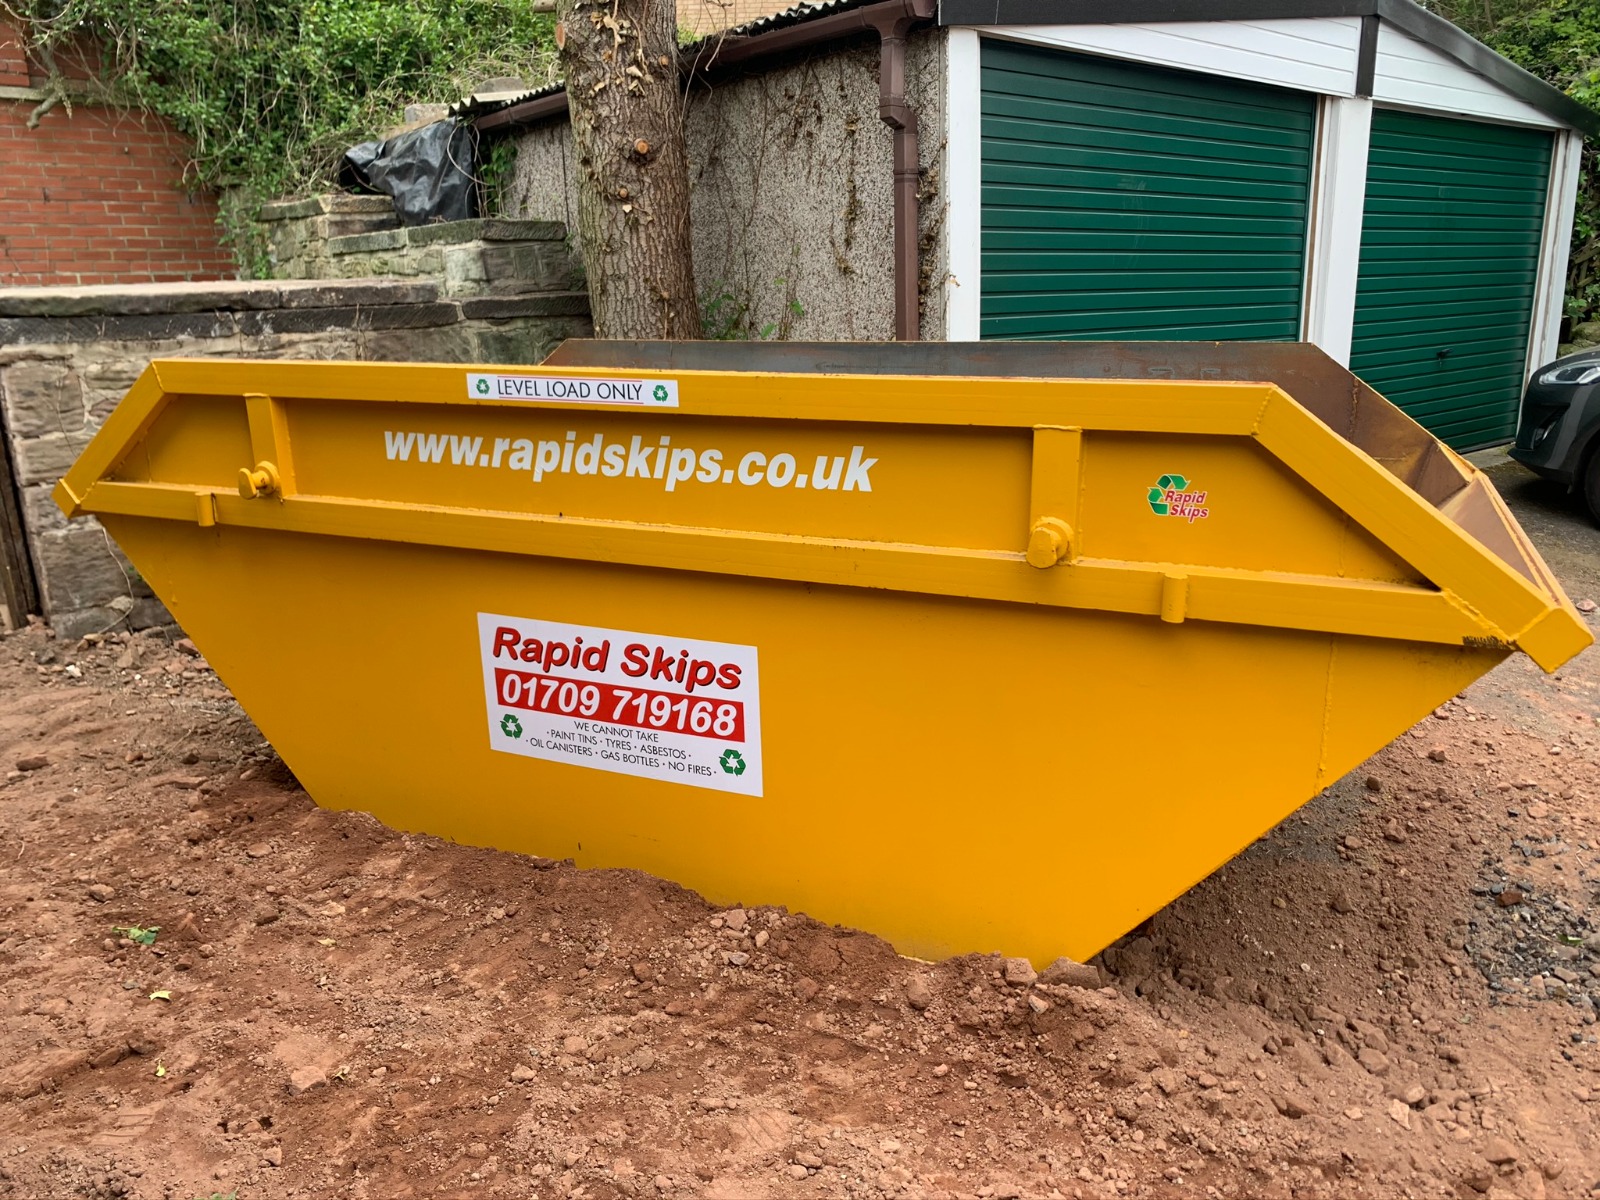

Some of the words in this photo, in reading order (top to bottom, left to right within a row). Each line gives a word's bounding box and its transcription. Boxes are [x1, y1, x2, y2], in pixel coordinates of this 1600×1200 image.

[498, 379, 541, 397] LEVEL
[547, 381, 591, 399] LOAD
[597, 382, 643, 401] ONLY
[384, 430, 879, 493] www.rapidskips.co.uk
[1165, 490, 1207, 504] Rapid
[1170, 504, 1208, 523] Skips
[493, 626, 610, 673] Rapid
[620, 643, 742, 693] Skips
[502, 673, 600, 716] 01709
[612, 690, 737, 737] 719168
[551, 729, 575, 742] PAINT
[578, 733, 598, 746] TINS
[605, 738, 631, 751] TYRES
[640, 744, 687, 760] ASBESTOS
[574, 720, 590, 732] WE
[592, 723, 633, 739] CANNOT
[636, 730, 659, 743] TAKE
[530, 737, 544, 748] OIL
[546, 740, 593, 757] CANISTERS
[601, 749, 621, 762] GAS
[623, 753, 660, 768] BOTTLES
[668, 761, 685, 772] NO
[688, 763, 712, 777] FIRES
